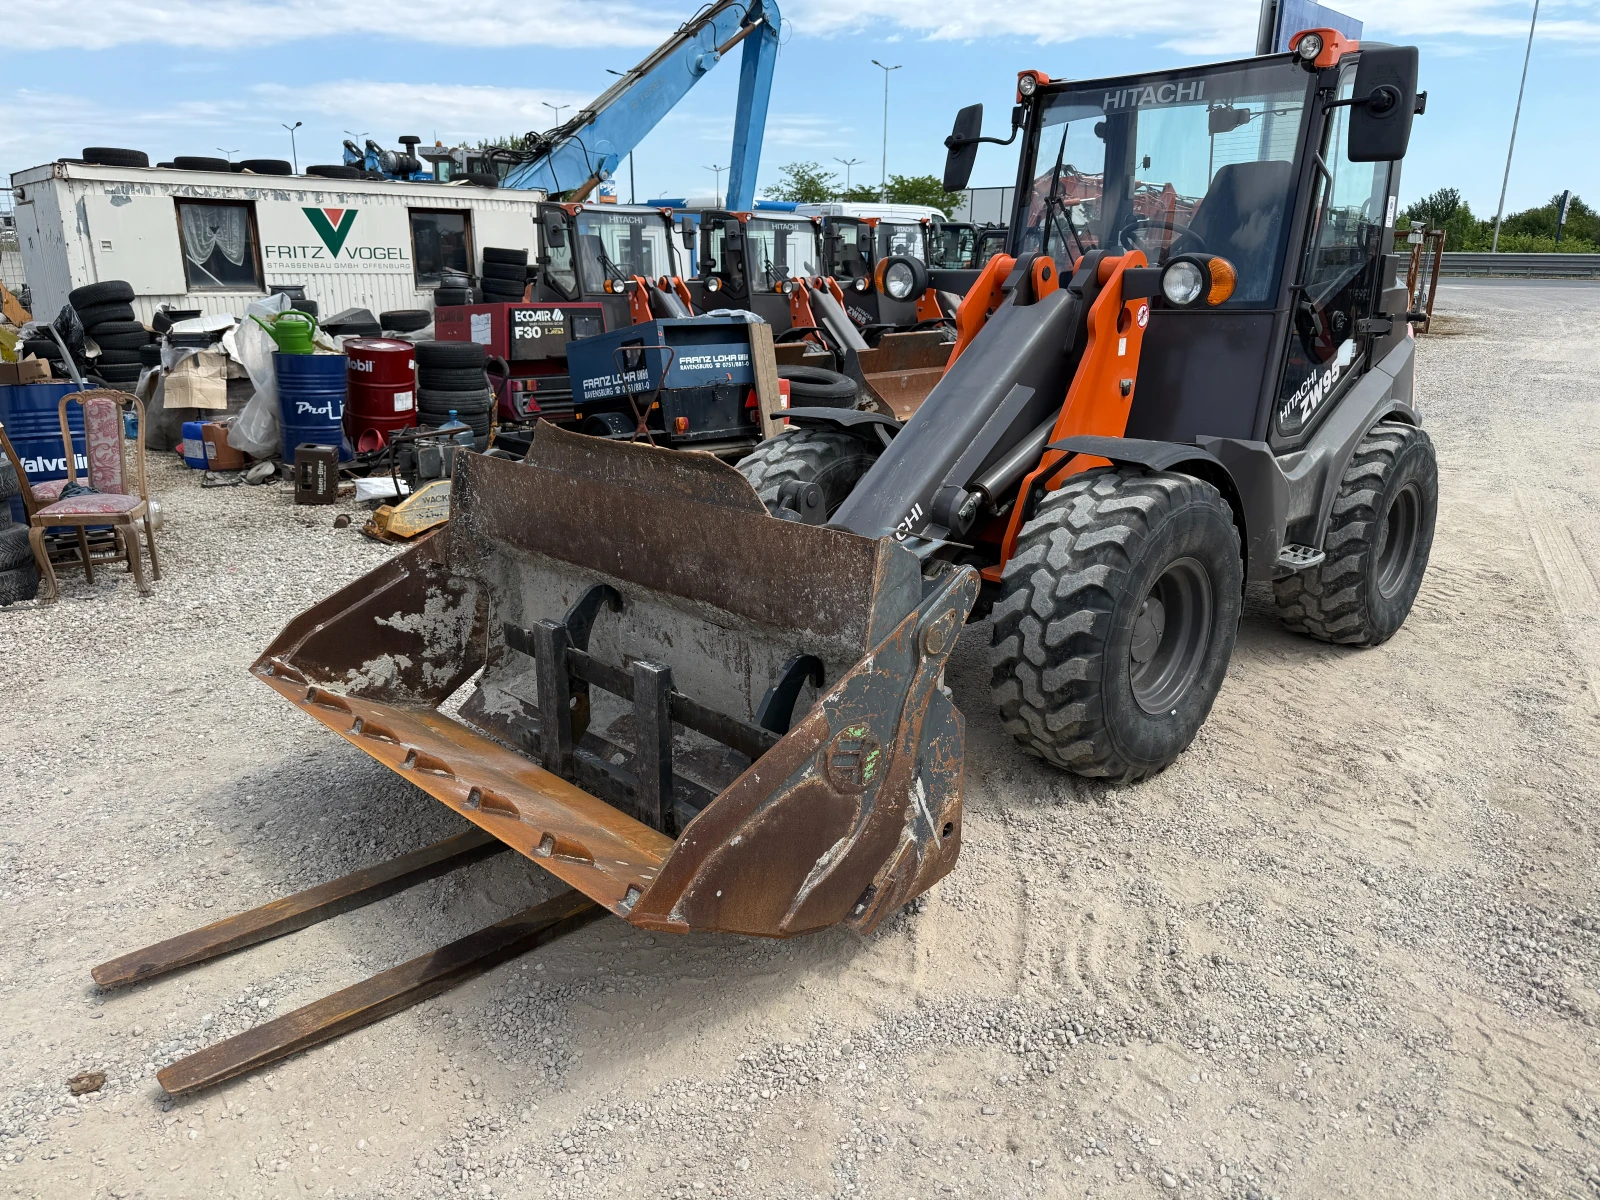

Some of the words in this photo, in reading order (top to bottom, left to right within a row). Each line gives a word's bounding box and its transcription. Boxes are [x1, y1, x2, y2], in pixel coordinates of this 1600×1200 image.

[1102, 81, 1206, 111] HITACHI
[608, 215, 643, 225] HITACHI
[771, 223, 799, 231] HITACHI
[265, 245, 325, 259] FRITZ
[345, 246, 410, 260] VOGEL
[514, 310, 552, 322] ECOAIR
[514, 326, 542, 340] F30
[679, 355, 712, 364] FRANZ
[712, 354, 737, 362] LOHR
[680, 362, 714, 371] RAVENSBURG
[582, 375, 612, 390] FRANZ
[584, 387, 614, 400] RAVENSBURG
[621, 381, 650, 394] 051/881-0
[1280, 368, 1318, 424] HITACHI
[1300, 359, 1340, 425] ZW95
